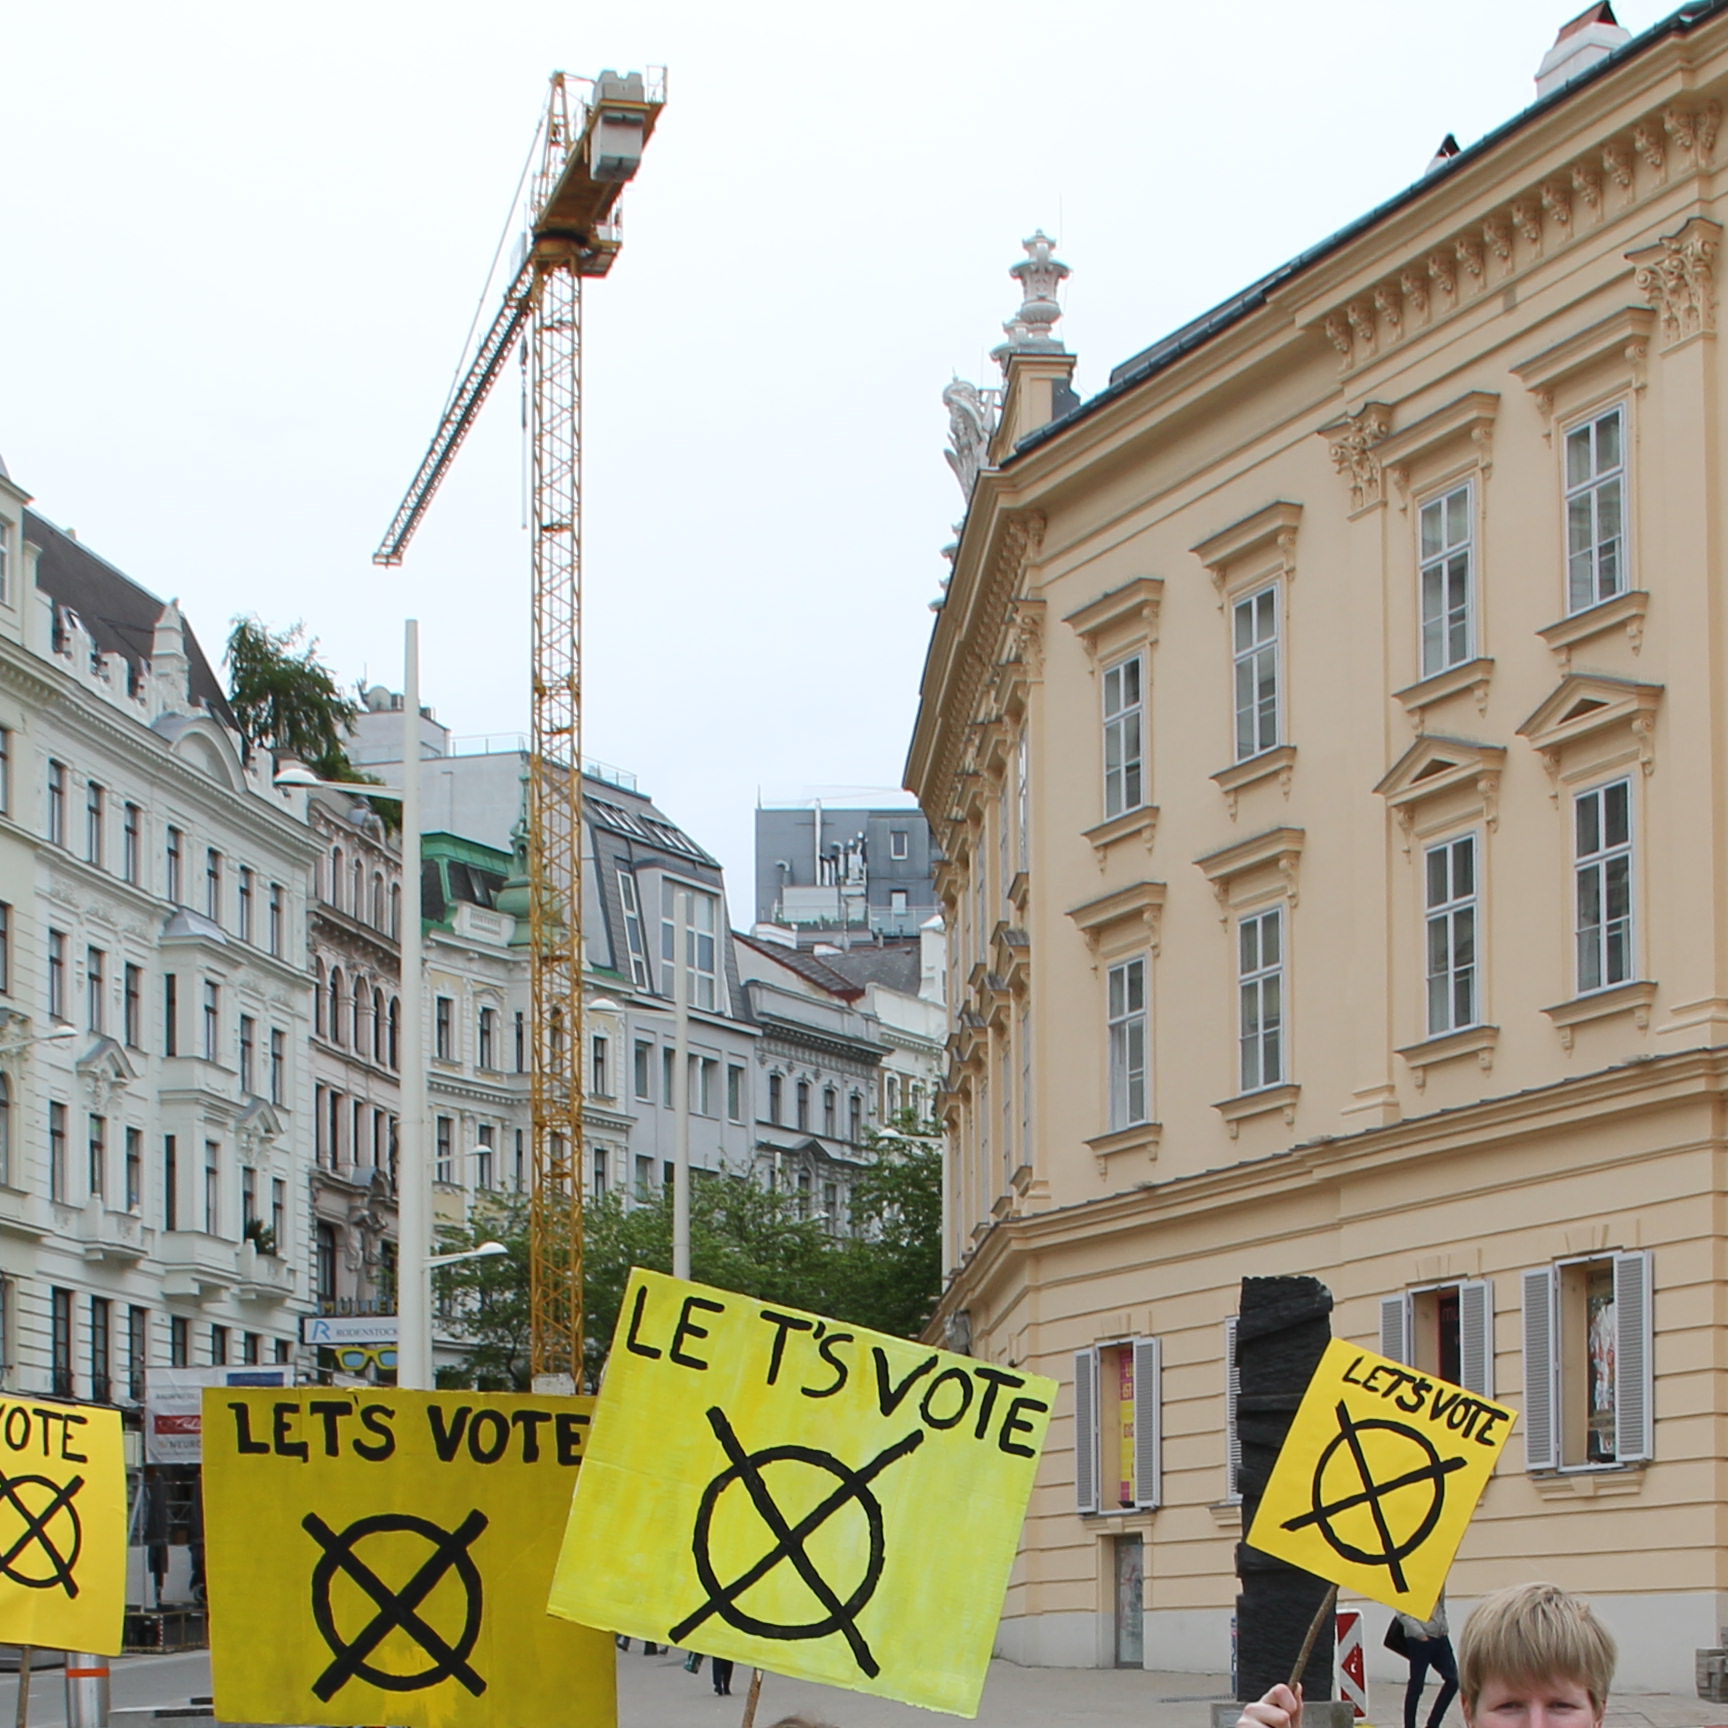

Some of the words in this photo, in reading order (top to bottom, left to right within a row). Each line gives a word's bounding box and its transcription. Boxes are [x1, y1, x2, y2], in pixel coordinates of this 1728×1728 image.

[227, 1395, 396, 1463] LET'S
[426, 1403, 591, 1467] VOTE
[872, 1346, 1049, 1459] VOTE
[1342, 1355, 1434, 1413] LET'S
[1429, 1387, 1510, 1447] VOTE
